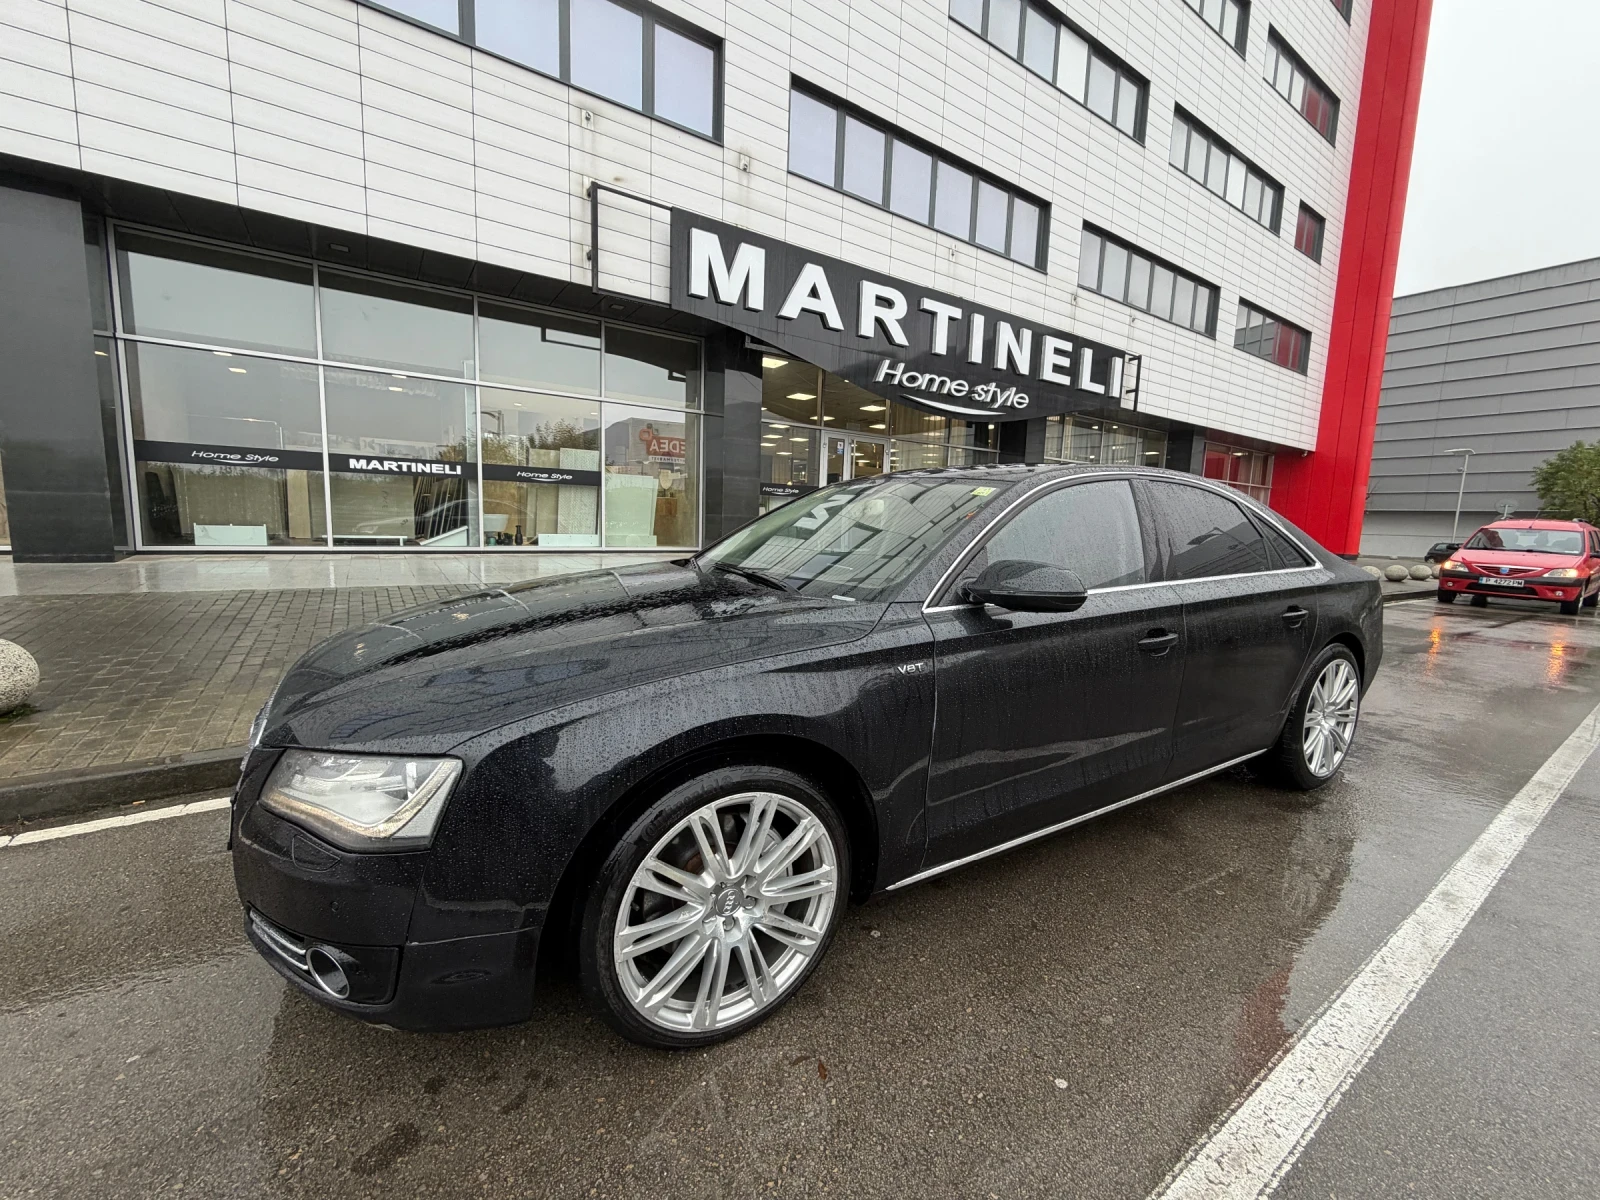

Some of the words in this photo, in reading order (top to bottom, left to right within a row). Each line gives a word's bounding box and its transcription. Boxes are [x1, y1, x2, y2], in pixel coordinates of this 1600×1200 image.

[688, 227, 1122, 398] MARTINELI
[872, 359, 969, 397] Home
[971, 382, 1029, 409] style
[191, 450, 241, 460] Home
[245, 453, 279, 463] Style
[349, 458, 462, 475] MARTINELI
[517, 471, 549, 479] Home
[550, 472, 573, 481] Style
[897, 662, 924, 675] V8T
